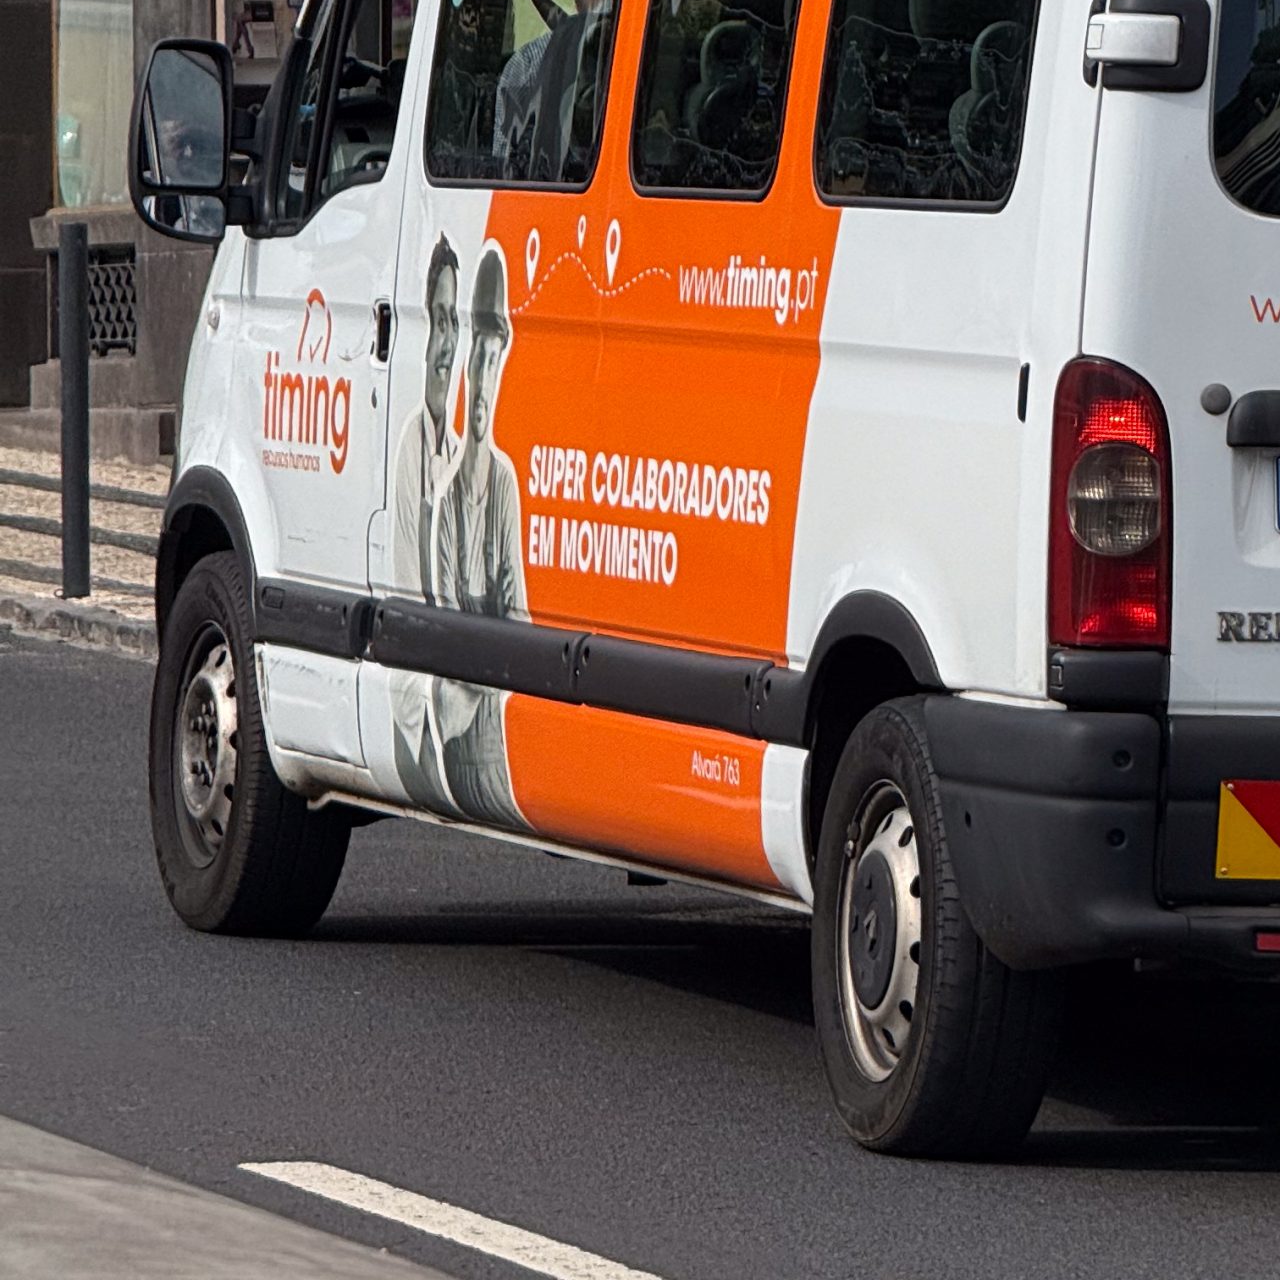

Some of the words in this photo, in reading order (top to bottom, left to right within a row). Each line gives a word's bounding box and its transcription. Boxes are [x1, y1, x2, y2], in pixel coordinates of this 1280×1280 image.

[679, 255, 818, 325] www.timing.pt
[264, 351, 351, 474] timing
[529, 444, 587, 502] SUPER
[591, 451, 771, 526] COLABORADORES
[528, 514, 555, 567] EM
[560, 518, 678, 586] MOVIMENTO
[691, 749, 722, 782] Alvará
[723, 755, 740, 786] 763
